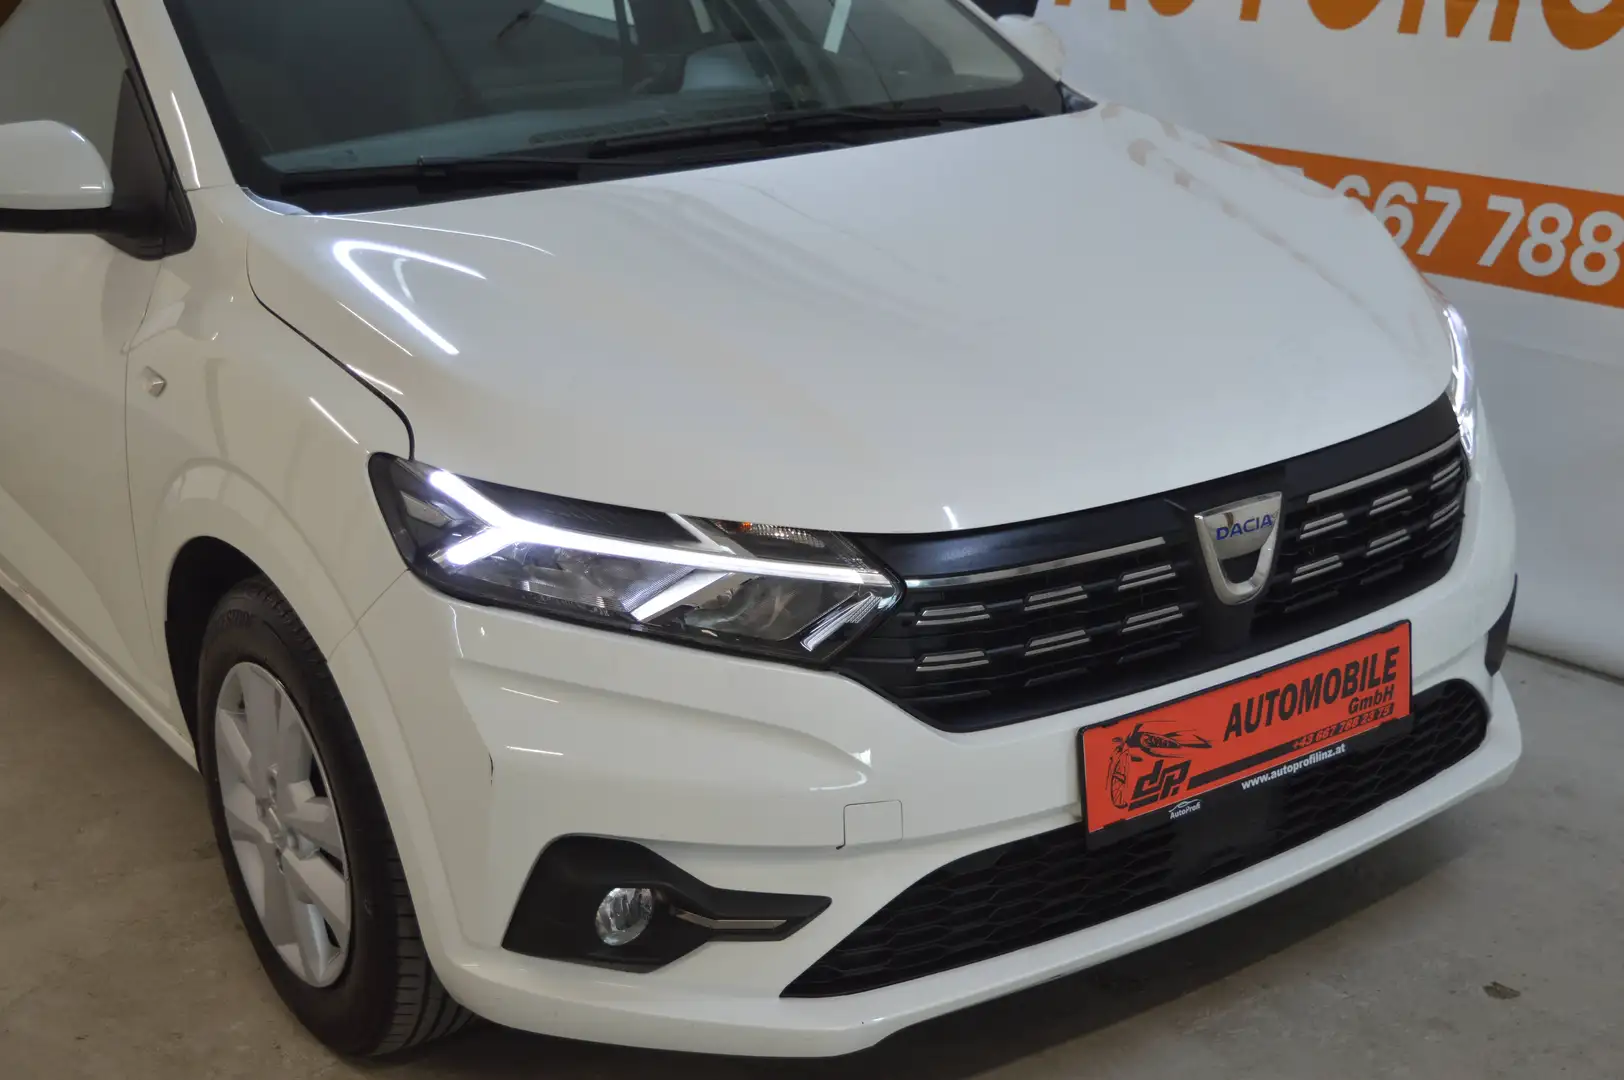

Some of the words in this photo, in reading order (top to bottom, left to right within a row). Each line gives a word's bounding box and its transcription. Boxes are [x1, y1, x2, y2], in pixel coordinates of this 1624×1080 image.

[1476, 194, 1624, 287] 788
[1216, 513, 1273, 541] DACIA
[1223, 646, 1400, 742] AUTOMOBILE
[1348, 684, 1395, 715] GmbH
[1241, 743, 1346, 790] www.autoprofilinz.at
[1169, 801, 1201, 819] AutoProfi
